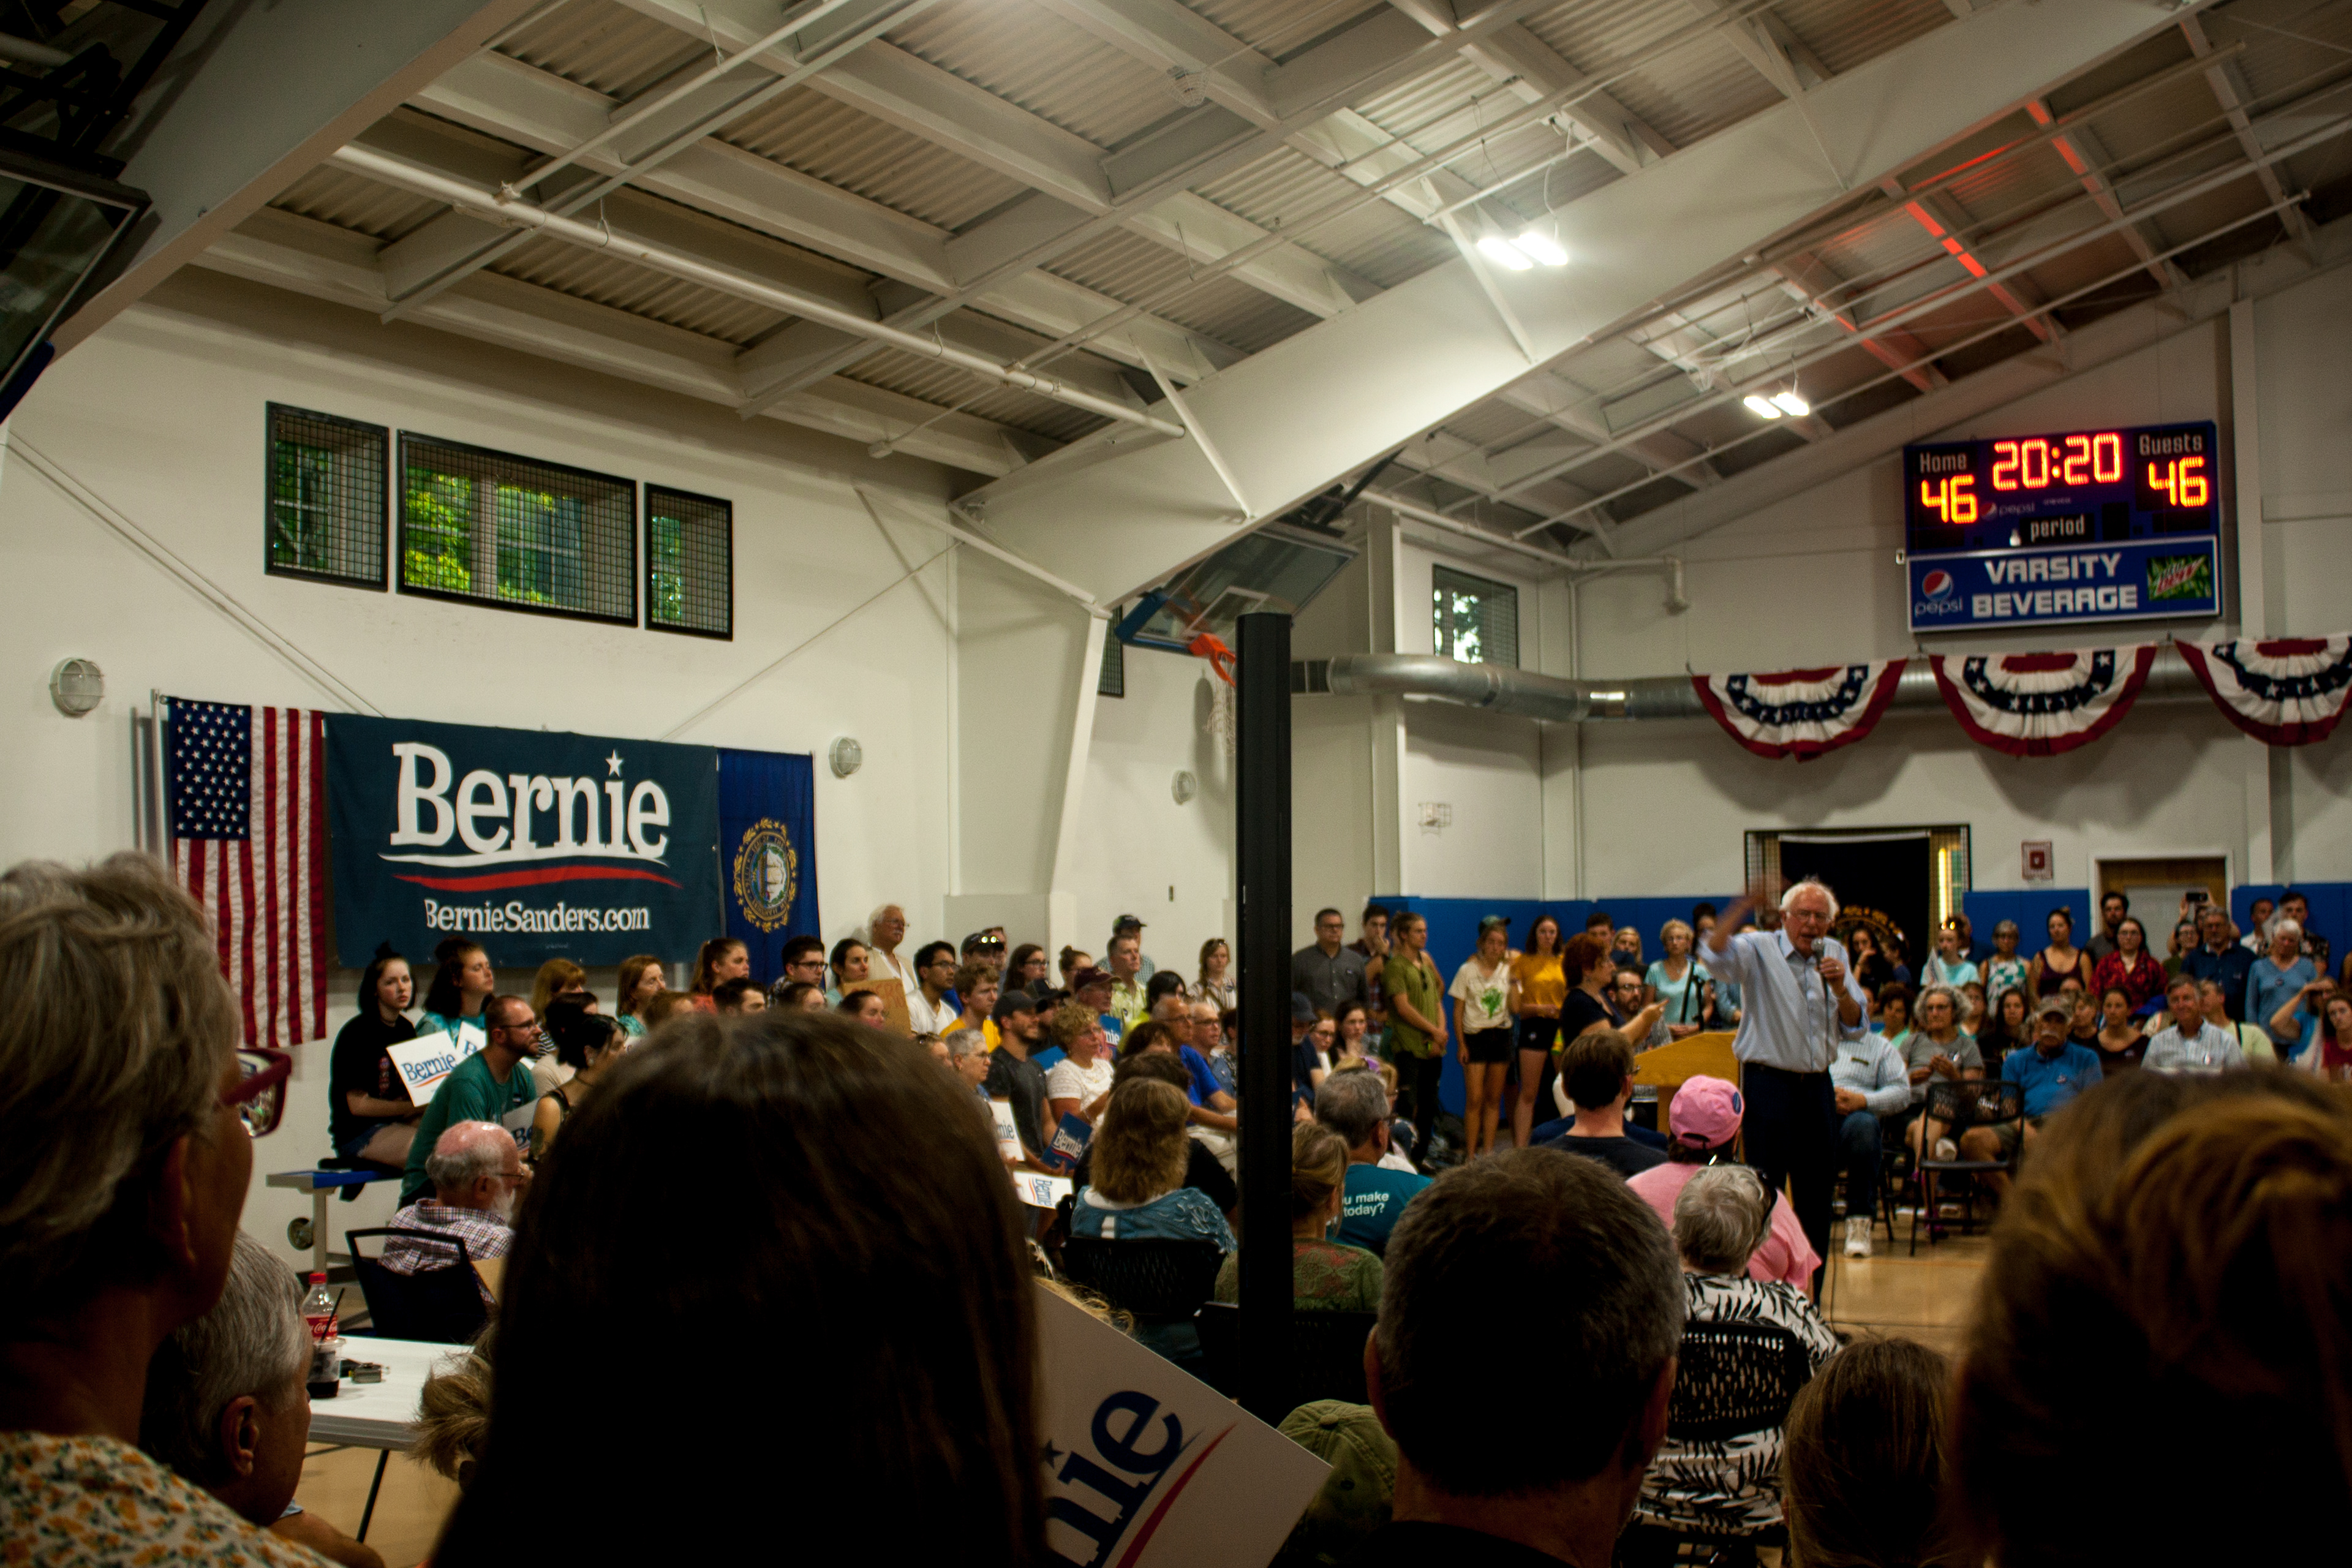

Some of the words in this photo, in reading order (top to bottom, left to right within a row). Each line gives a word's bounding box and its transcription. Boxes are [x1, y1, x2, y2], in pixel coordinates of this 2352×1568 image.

[2139, 433, 2203, 457] Guests
[1920, 452, 1967, 473] Home
[1992, 432, 2122, 491] 20:20
[2148, 456, 2208, 507] 46
[1921, 474, 1978, 524] 46
[2030, 514, 2085, 543] period
[1985, 553, 2122, 585] VARSITY
[1914, 595, 1964, 618] pepsi
[1972, 584, 2138, 619] BEVERAGE
[390, 742, 672, 859] Bernie
[424, 899, 650, 932] BernieSanders.com
[402, 1052, 458, 1081] Bernie
[1053, 1128, 1082, 1158] Bernie
[1343, 1202, 1385, 1217] today?
[1355, 1191, 1389, 1204] make
